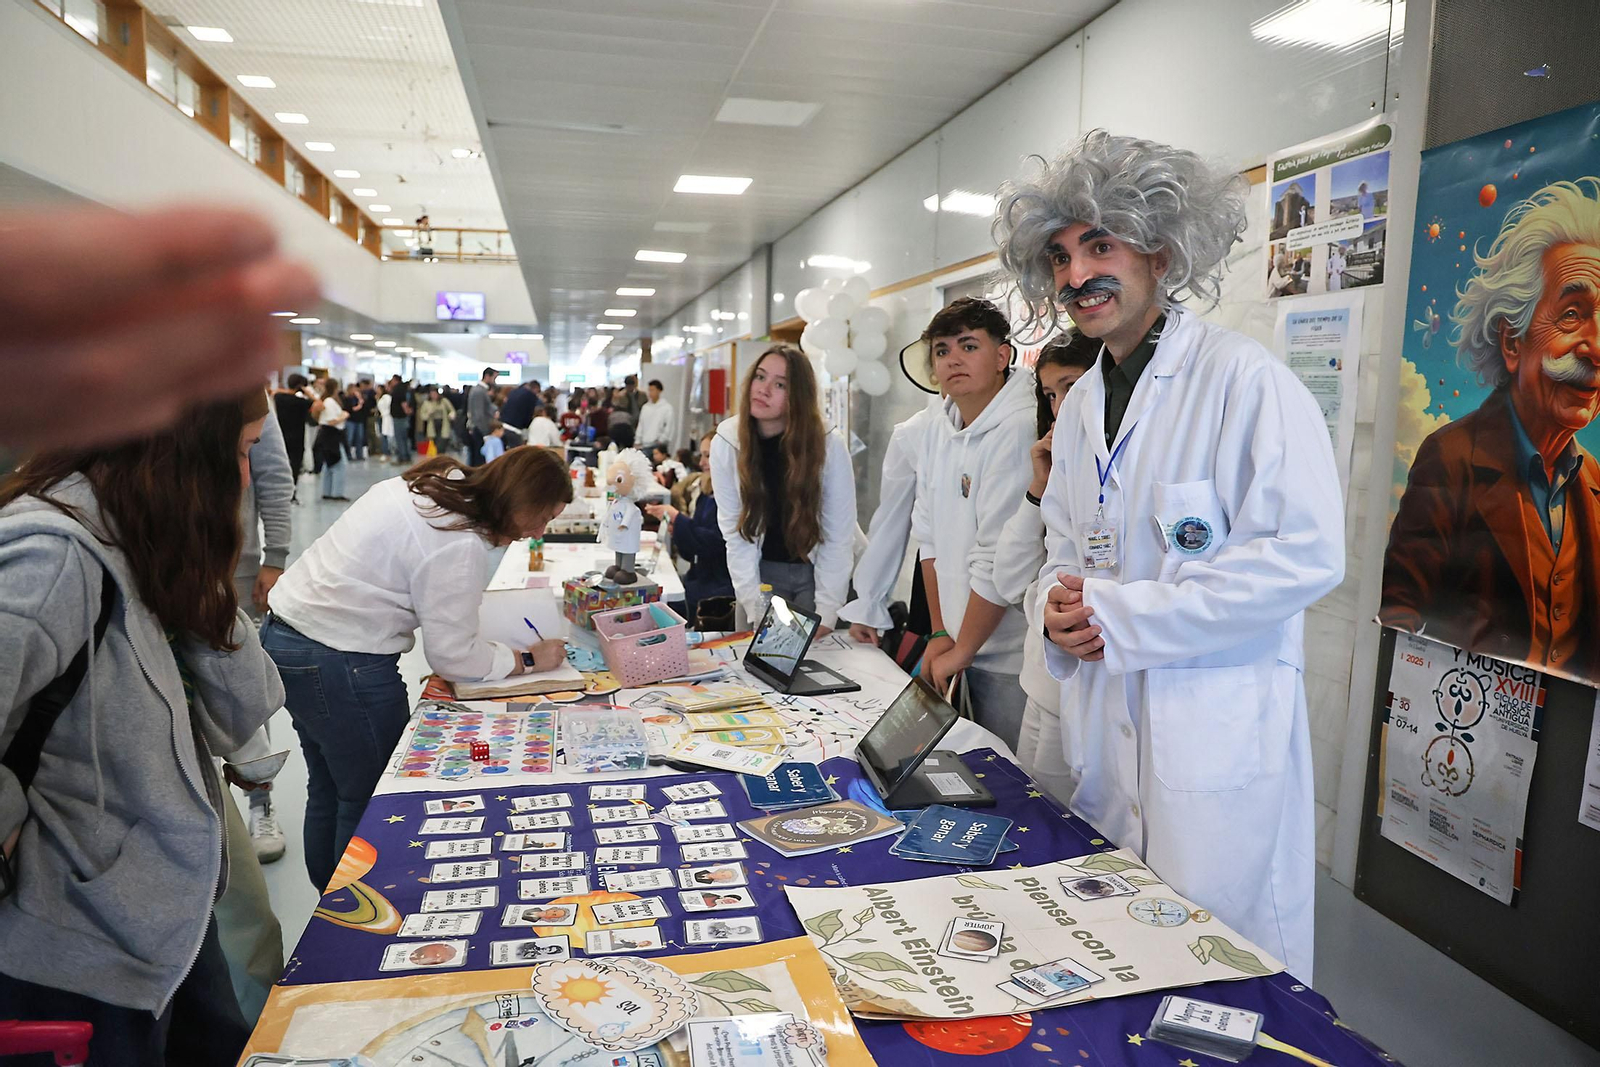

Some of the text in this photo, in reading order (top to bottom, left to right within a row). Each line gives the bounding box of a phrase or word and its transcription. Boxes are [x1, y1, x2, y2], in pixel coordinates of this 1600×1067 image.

[1406, 654, 1424, 666] 2025
[1495, 675, 1535, 703] XVIII
[1399, 701, 1410, 711] 30
[1494, 692, 1532, 712] CICLO DE
[1396, 718, 1419, 734] 07-14
[1493, 708, 1530, 727] ANTIGUA
[765, 773, 781, 792] anar
[930, 818, 957, 843] ganar
[612, 904, 628, 919] ciencia
[642, 899, 655, 917] Memory
[862, 887, 975, 1015] Albert Einstein
[1072, 930, 1116, 961] con
[1108, 965, 1140, 983] la
[1174, 1002, 1201, 1024] Memory
[1214, 1011, 1232, 1032] ciencia
